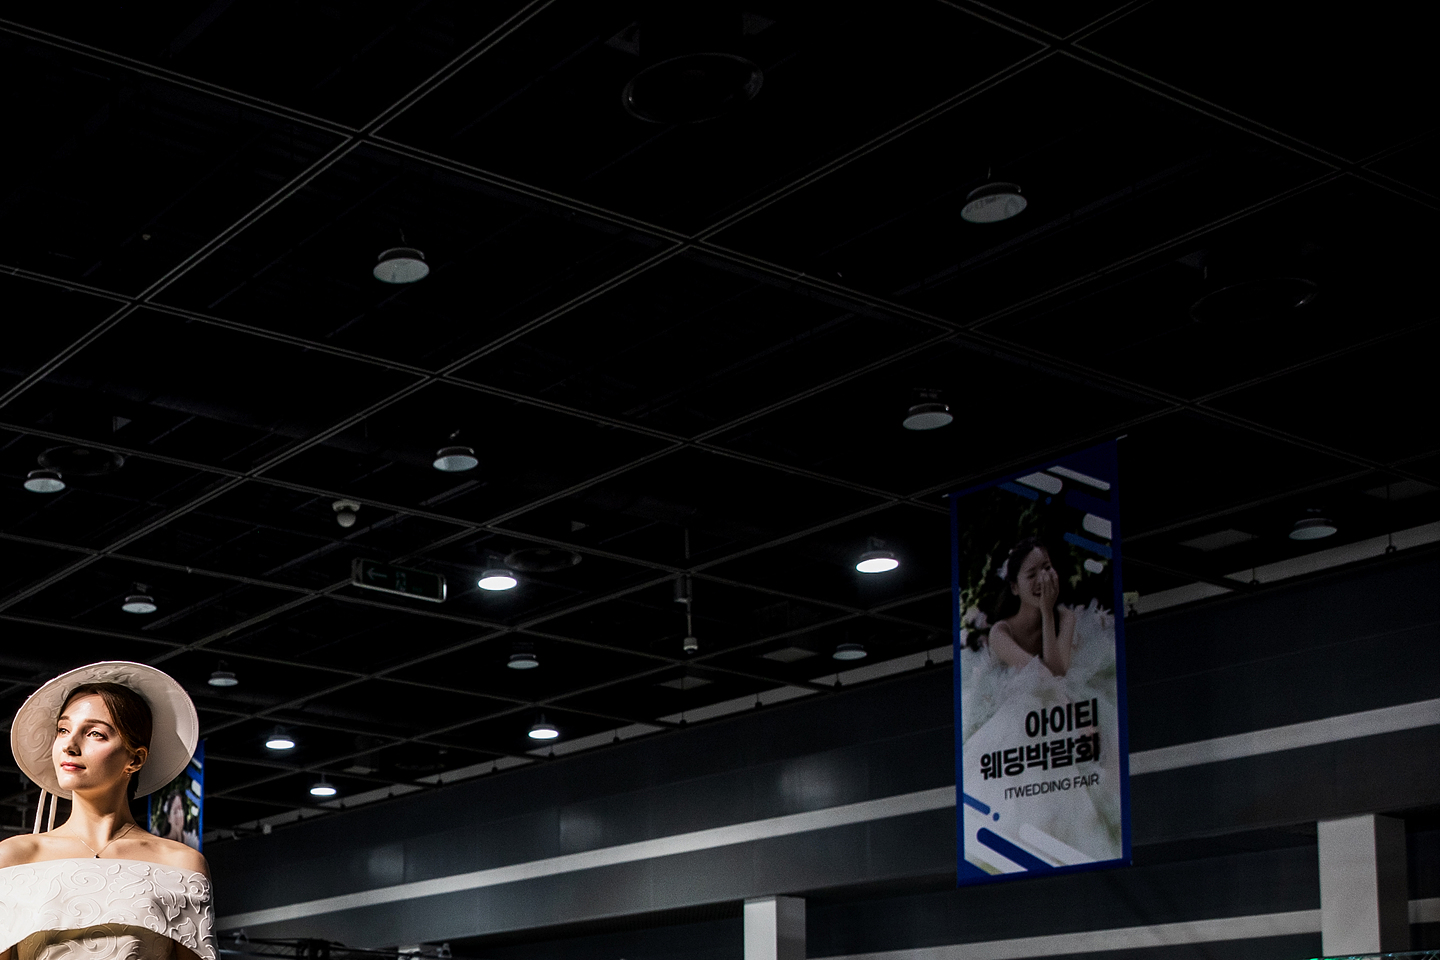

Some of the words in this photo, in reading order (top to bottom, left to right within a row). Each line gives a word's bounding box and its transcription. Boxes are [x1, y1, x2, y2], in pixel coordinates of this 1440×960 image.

[1025, 698, 1098, 737] 아이티
[980, 733, 1100, 780] 웨딩박람회
[1004, 778, 1071, 800] ITWEDDING
[1073, 773, 1099, 789] FAIR
